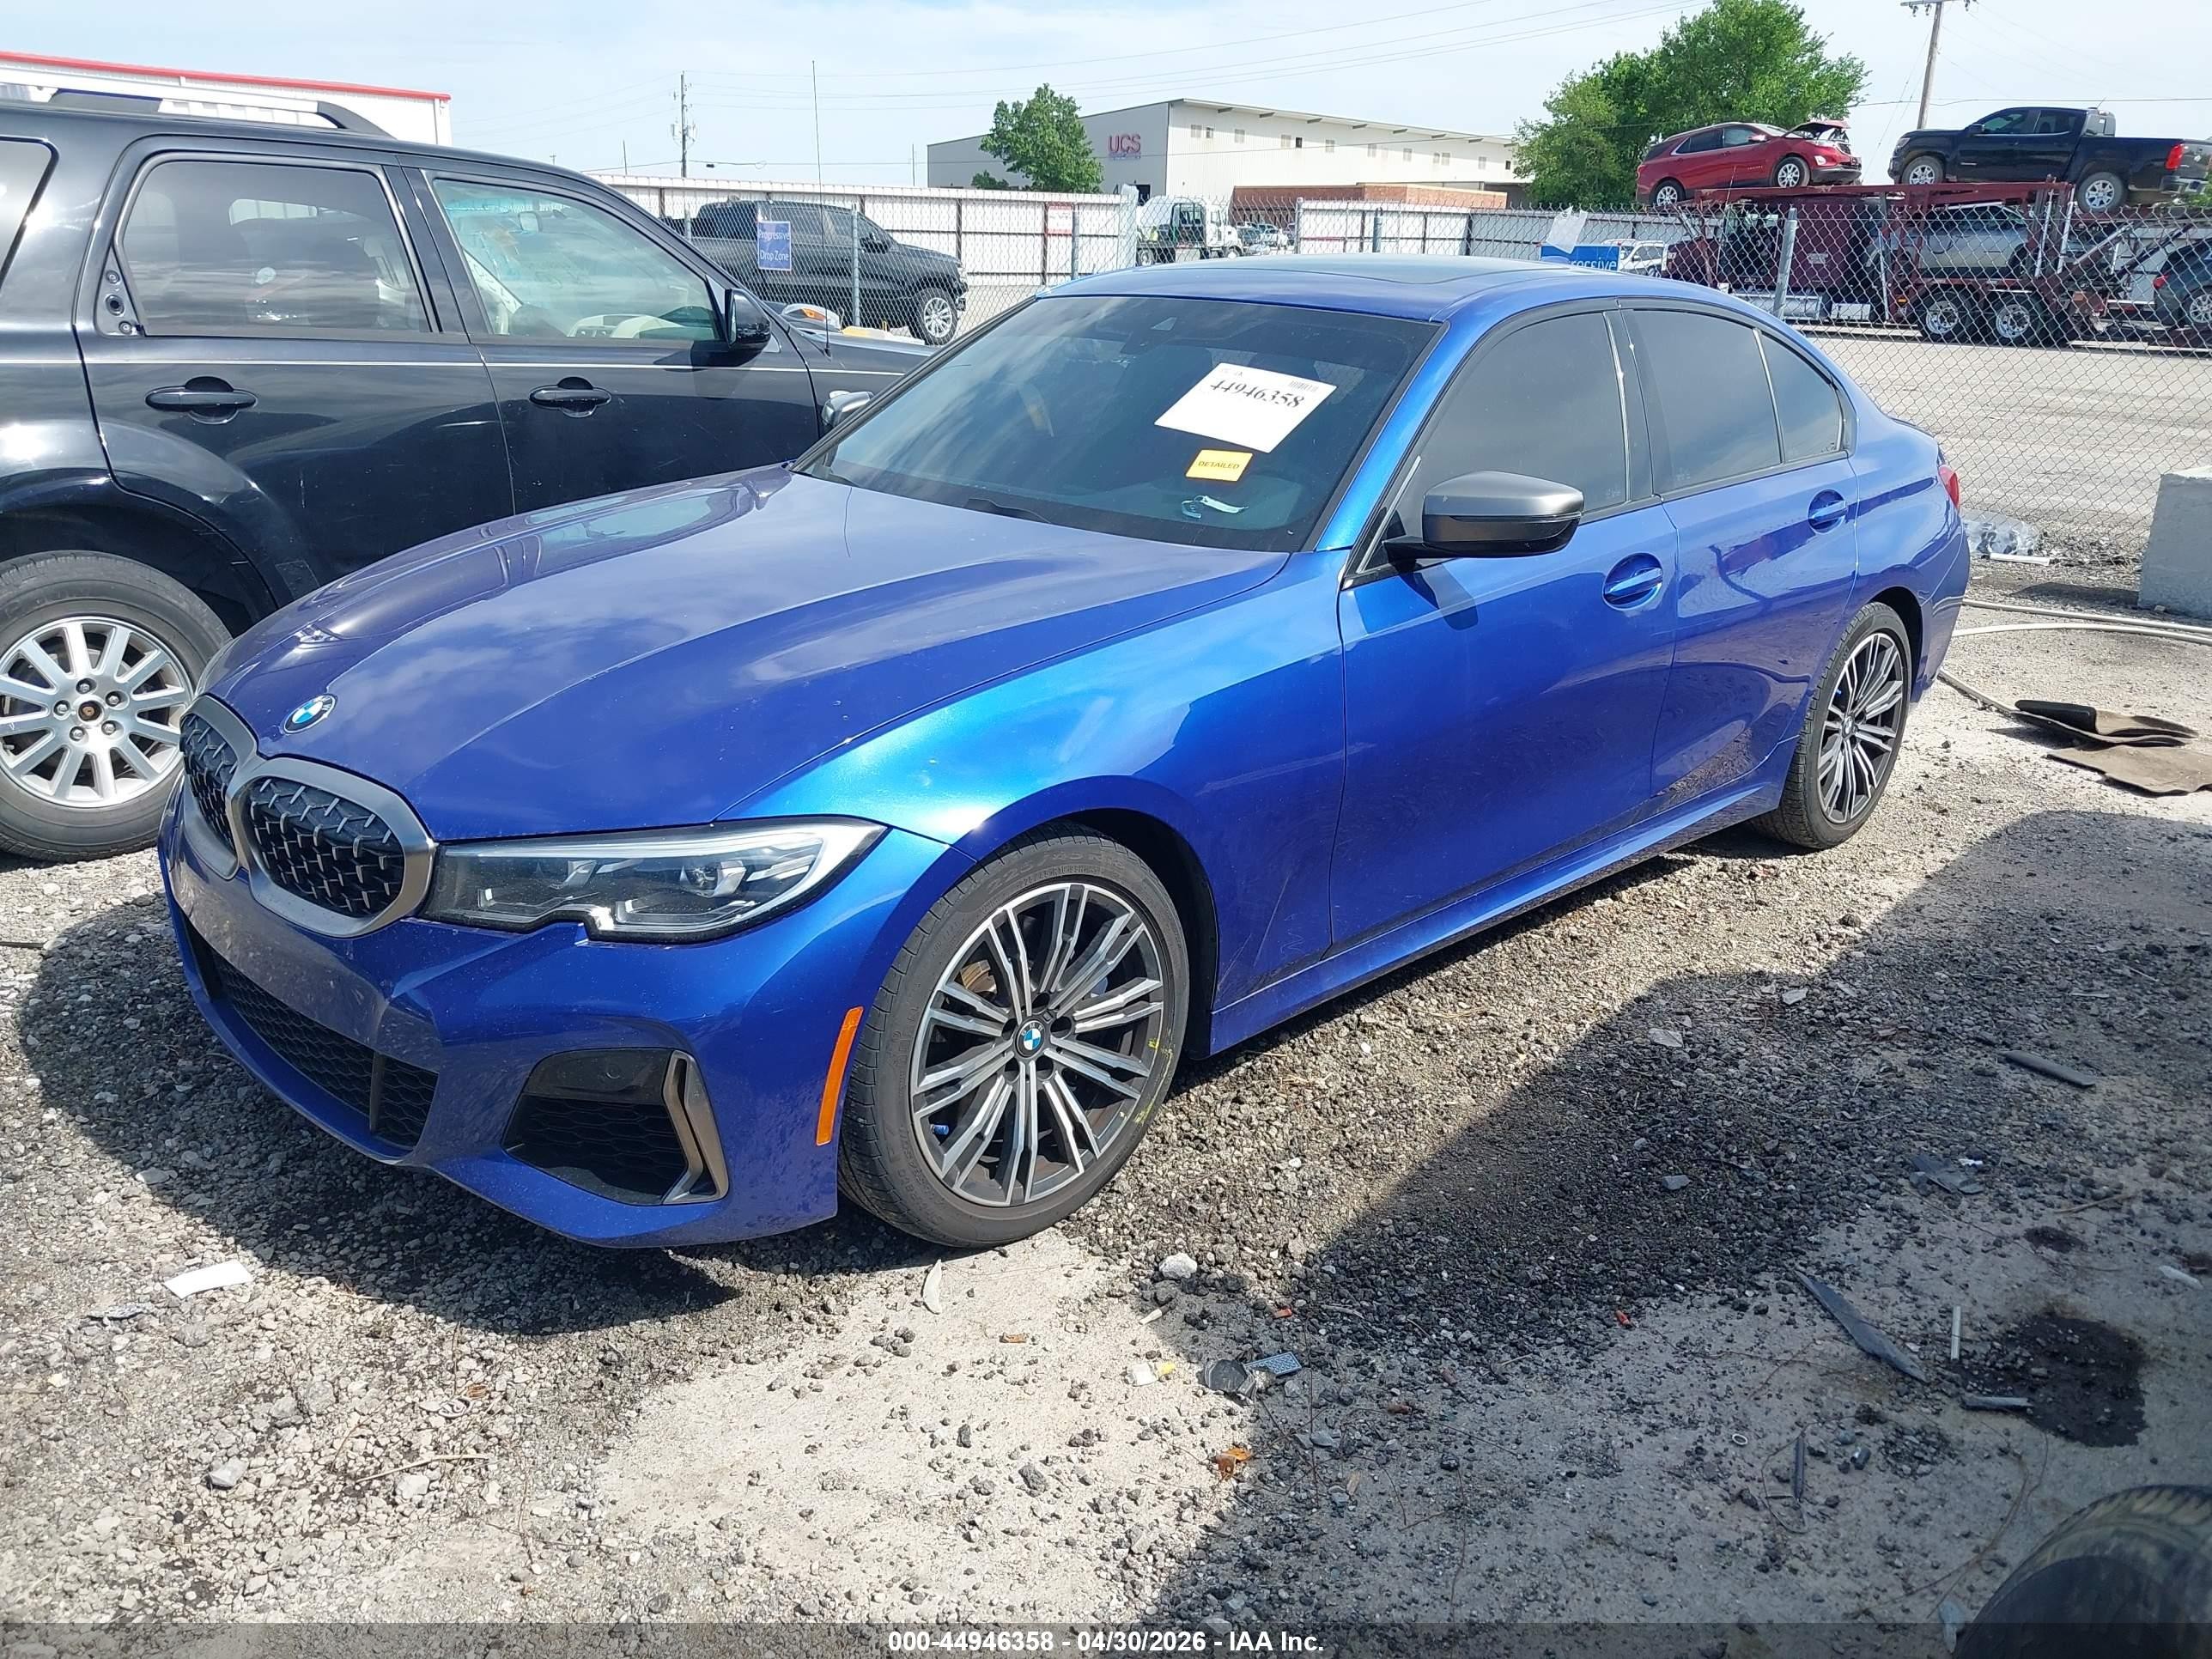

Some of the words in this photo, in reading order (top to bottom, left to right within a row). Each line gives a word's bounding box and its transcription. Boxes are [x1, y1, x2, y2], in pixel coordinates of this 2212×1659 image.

[1108, 134, 1141, 153] UCS
[757, 229, 790, 240] Progressive
[760, 249, 774, 262] Drop
[775, 250, 789, 261] Zone
[1210, 380, 1305, 408] 44946358
[1198, 460, 1240, 470] DETAILED
